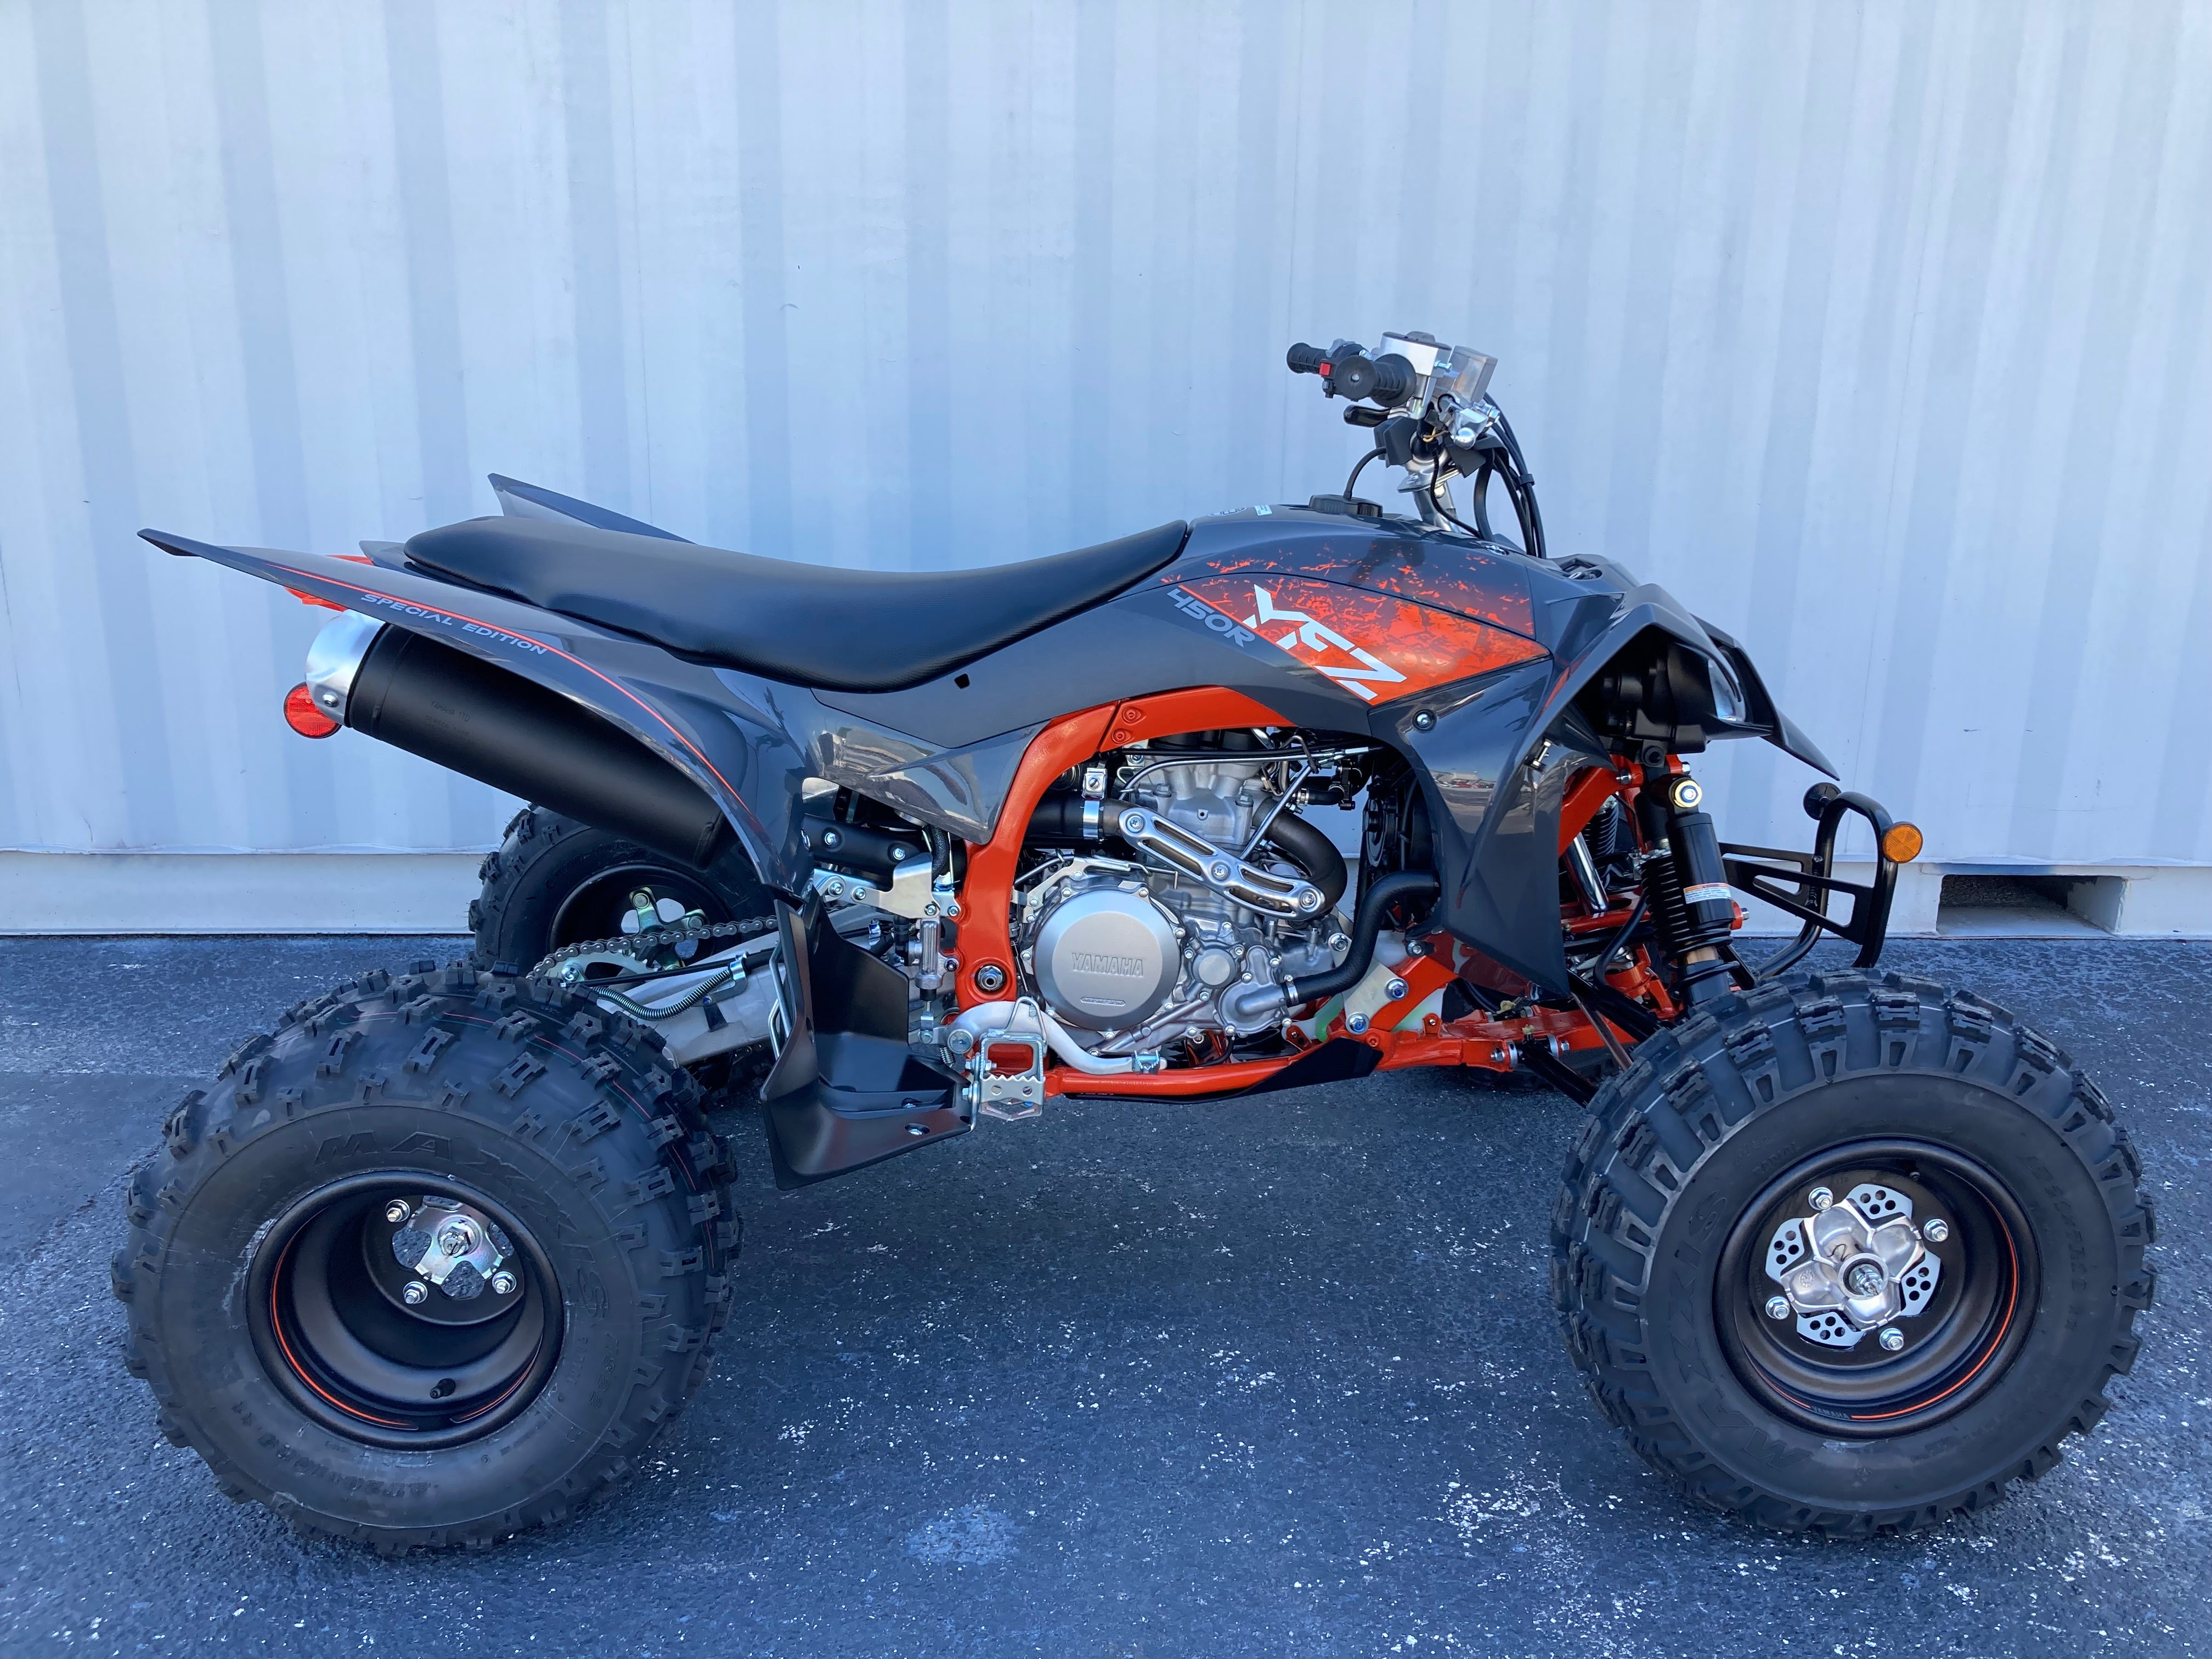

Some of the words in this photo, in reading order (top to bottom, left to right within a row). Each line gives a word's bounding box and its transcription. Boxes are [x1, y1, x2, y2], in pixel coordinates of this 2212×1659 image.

[361, 594, 453, 626] SPECIAL
[462, 623, 548, 655] EDITION
[1166, 588, 1256, 647] 450R
[1242, 584, 1408, 701] YFZ
[431, 699, 455, 716] YAMAHA
[1071, 952, 1143, 978] YAMAHA
[314, 1130, 609, 1319] MAXXIS
[1669, 1189, 1815, 1470] MAXXIS
